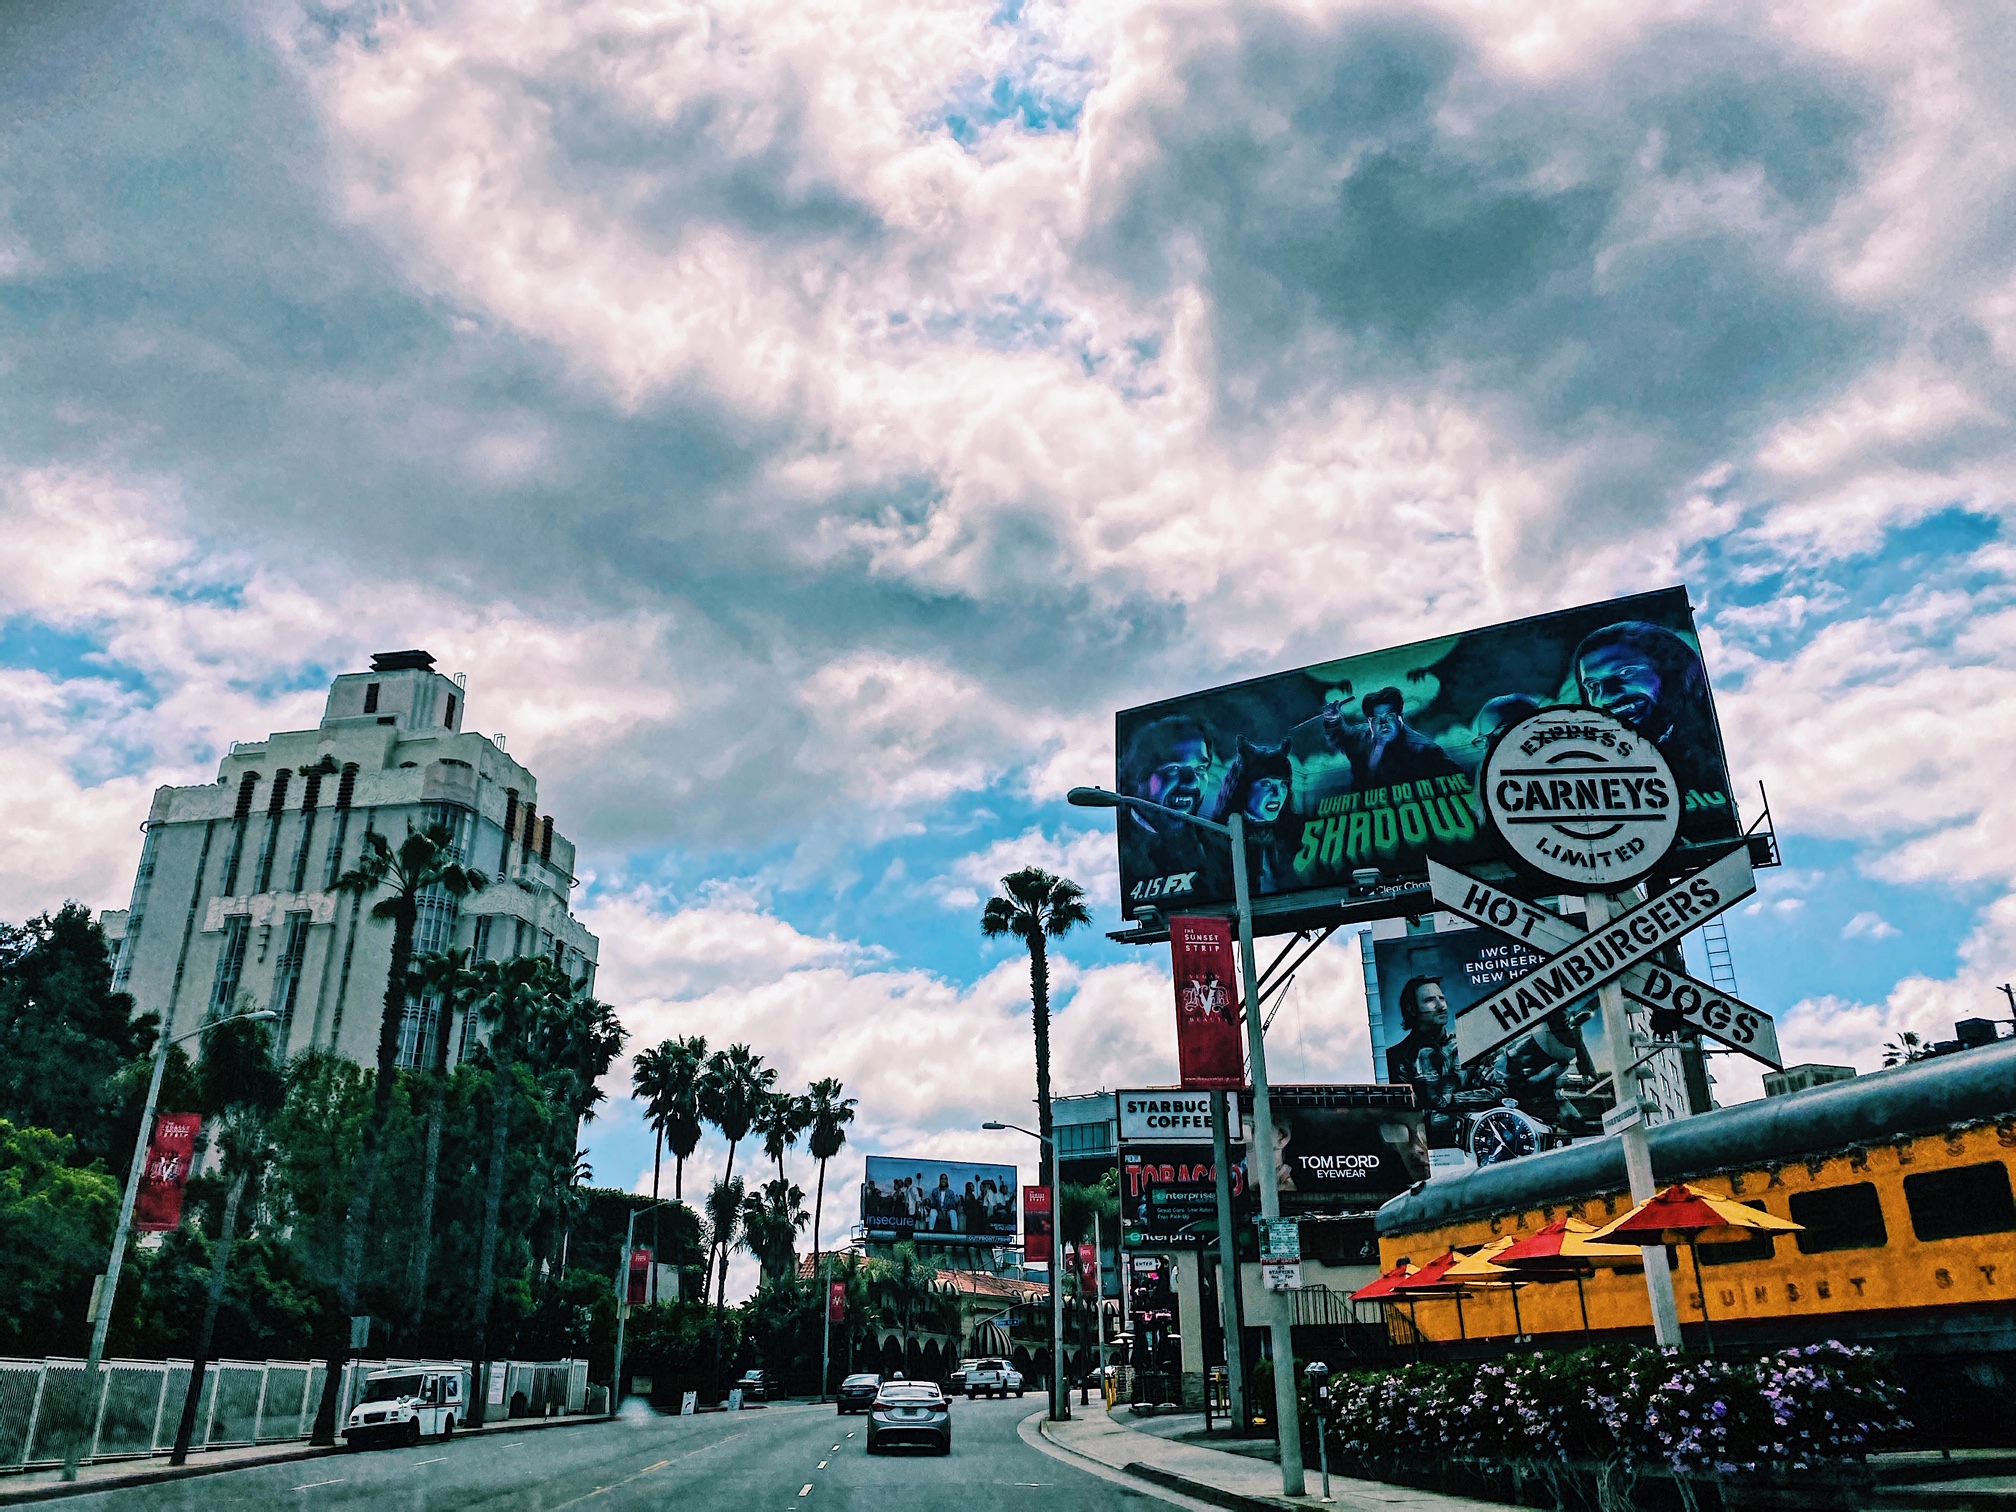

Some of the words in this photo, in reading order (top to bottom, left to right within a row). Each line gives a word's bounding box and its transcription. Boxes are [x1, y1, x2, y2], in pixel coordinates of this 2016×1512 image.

[1520, 724, 1634, 757] EXPRESS
[1318, 791, 1361, 816] WHAT
[1365, 787, 1388, 807] WE
[1391, 783, 1413, 801] DO
[1415, 778, 1434, 799] IN
[1435, 773, 1475, 795] THE
[1496, 777, 1670, 812] CARNEYS
[1293, 793, 1477, 872] SHADOW
[1535, 836, 1646, 869] LIMITED
[1129, 876, 1163, 901] 4.15
[1162, 870, 1199, 895] FX
[1378, 884, 1403, 895] Clear
[1461, 883, 1547, 938] HOT
[1184, 933, 1220, 942] SUNSET
[1185, 944, 1220, 952] STRIP
[1481, 945, 1509, 959] IWC
[1488, 878, 1722, 1032] HAMBURGERS
[1471, 971, 1504, 985] NEW
[1641, 968, 1760, 1045] DOGS
[1127, 1100, 1231, 1114] STARBUCS
[1146, 1114, 1213, 1129] COFFEE
[1298, 1155, 1333, 1169] TOM
[1336, 1154, 1380, 1169] FORD
[1316, 1168, 1367, 1179] EYEWEAR
[866, 1213, 915, 1227] insecure
[1689, 1276, 1866, 1310] SUNSET
